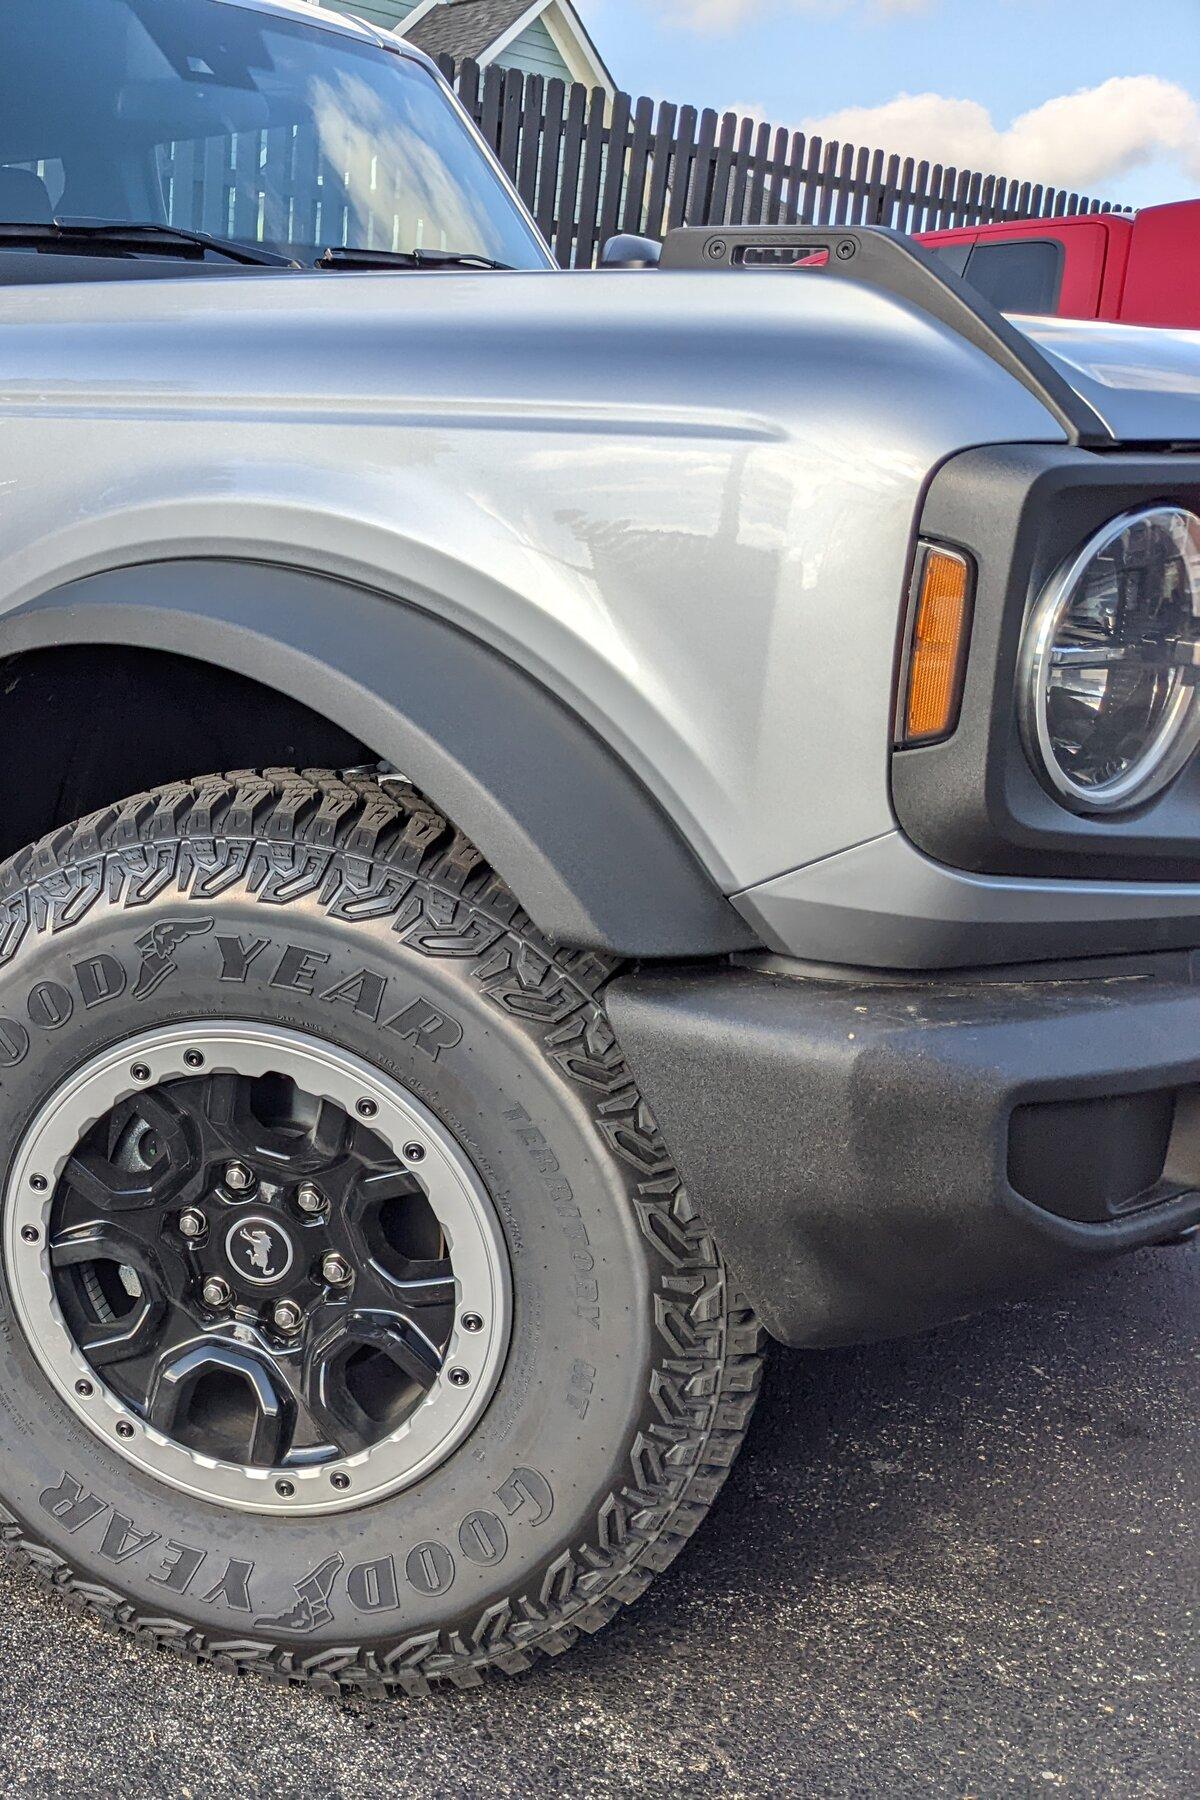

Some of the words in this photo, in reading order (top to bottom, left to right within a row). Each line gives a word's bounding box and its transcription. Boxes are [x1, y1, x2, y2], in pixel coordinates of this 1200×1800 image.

[214, 933, 464, 1062] YEAR
[39, 1469, 255, 1612] YEAR
[346, 1464, 555, 1613] GOOD
